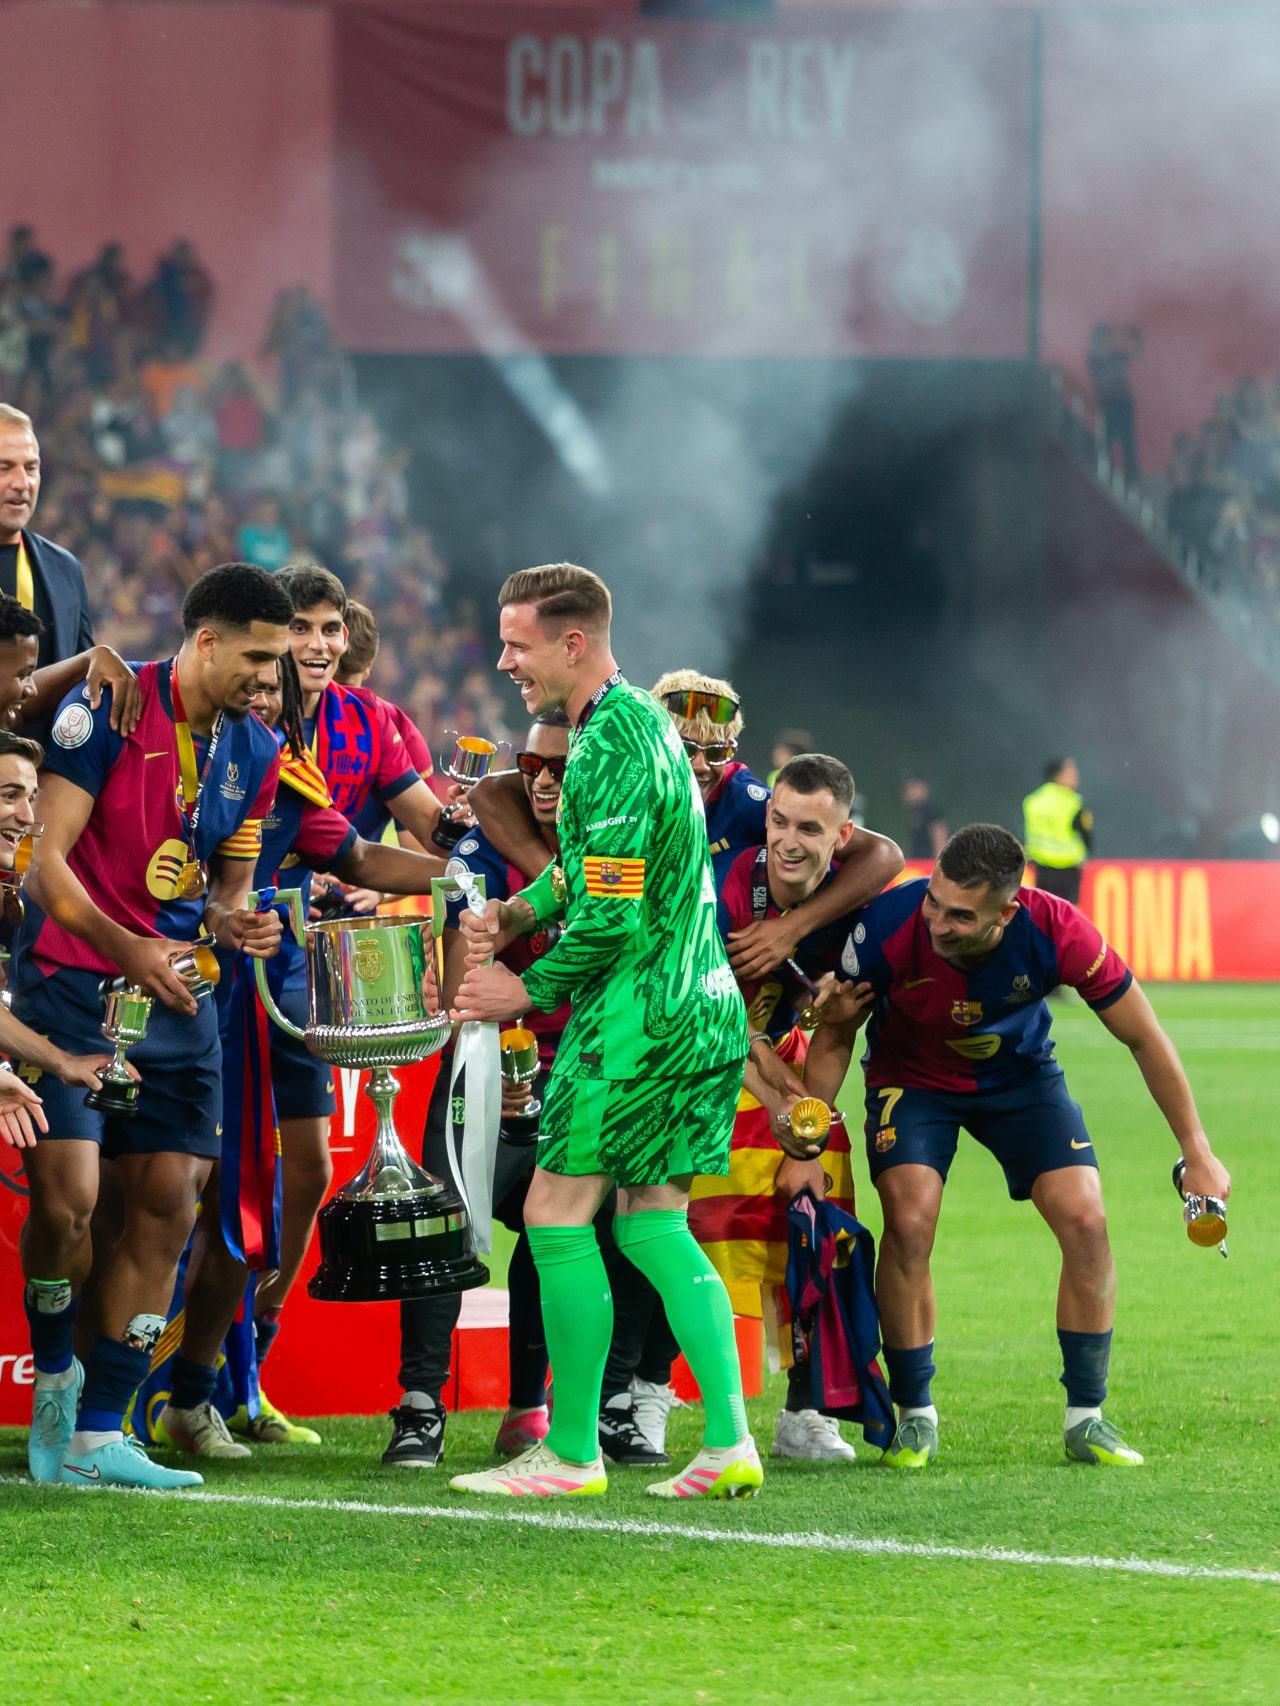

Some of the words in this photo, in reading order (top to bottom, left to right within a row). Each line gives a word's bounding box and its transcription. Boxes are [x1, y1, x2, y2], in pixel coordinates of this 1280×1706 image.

[506, 35, 662, 136] COPA
[745, 40, 858, 139] REY
[753, 886, 767, 908] 2025
[404, 1004, 417, 1012] RE
[878, 1087, 904, 1126] 7
